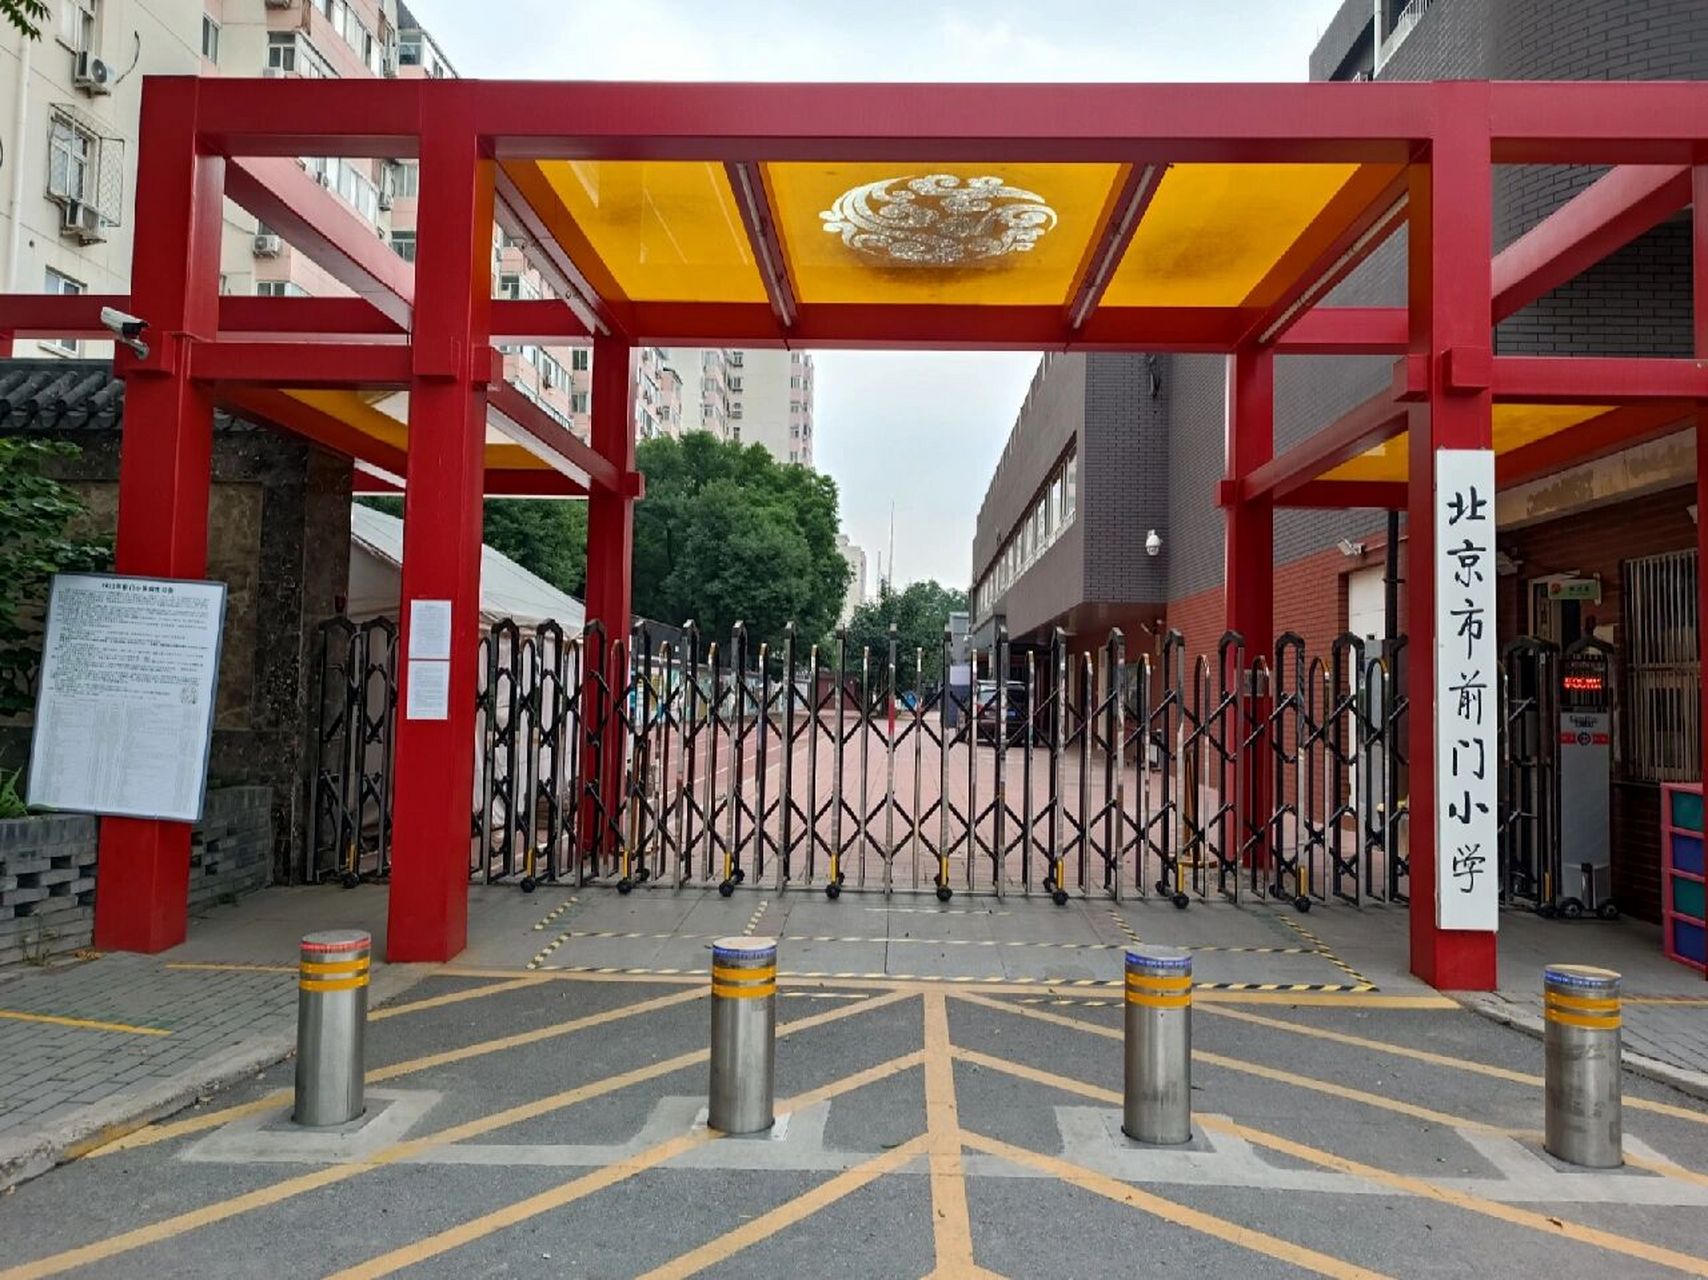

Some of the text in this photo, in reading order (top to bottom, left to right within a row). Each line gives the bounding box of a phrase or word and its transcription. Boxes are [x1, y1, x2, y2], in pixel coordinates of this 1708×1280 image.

[1446, 486, 1489, 893] 北京市前门小学
